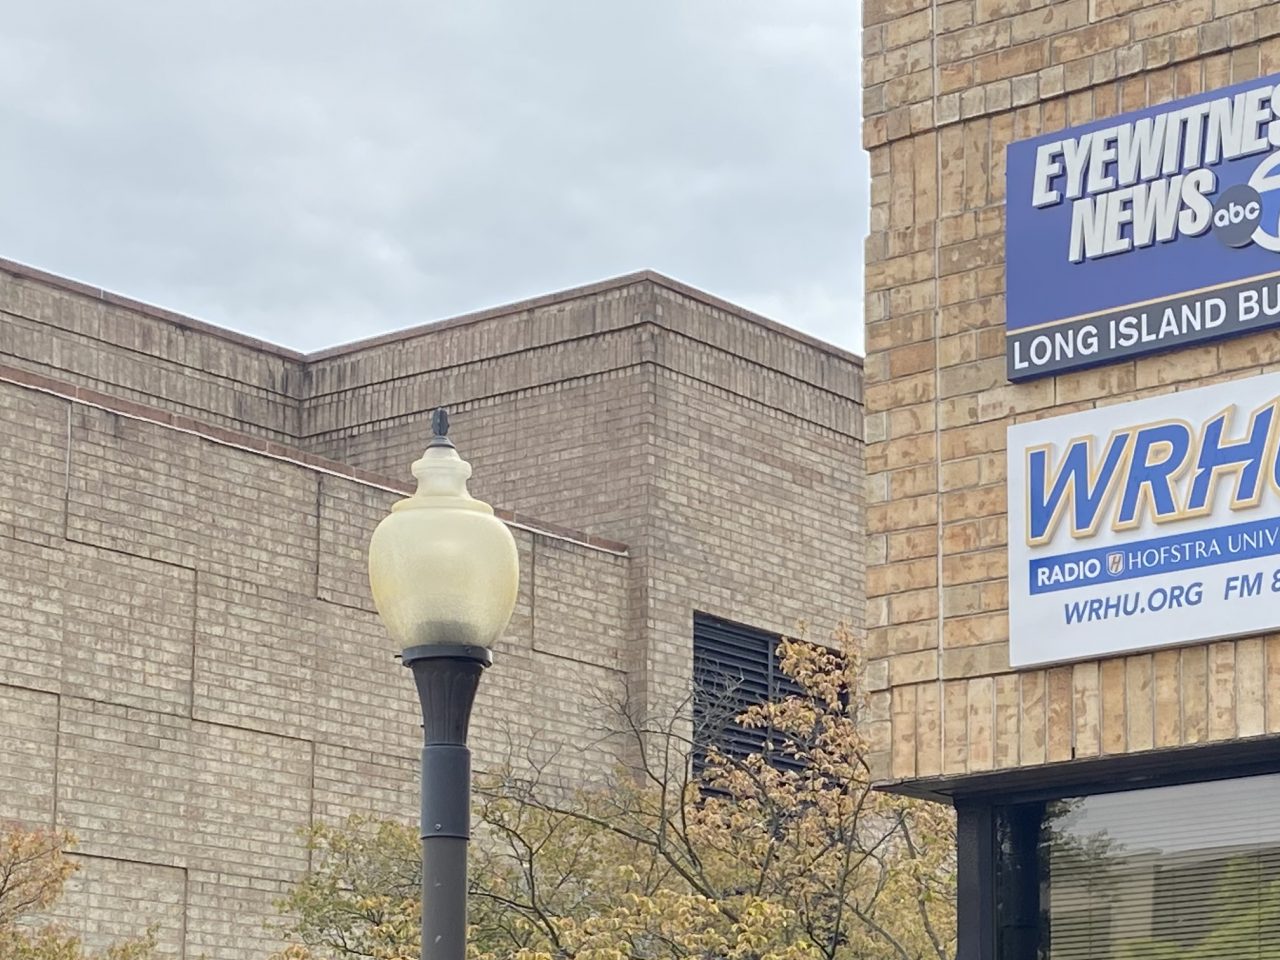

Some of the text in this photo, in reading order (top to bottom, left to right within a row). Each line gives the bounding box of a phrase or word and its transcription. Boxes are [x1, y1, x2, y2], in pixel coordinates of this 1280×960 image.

[1068, 168, 1217, 264] NEWS
[1213, 199, 1261, 228] abc
[1013, 325, 1099, 370] LONG
[1109, 297, 1227, 349] ISLAND
[1037, 558, 1101, 587] RADIO
[1128, 541, 1220, 570] HOFSTRA
[1064, 582, 1203, 625] WRHU.ORG
[1224, 572, 1263, 601] FM
